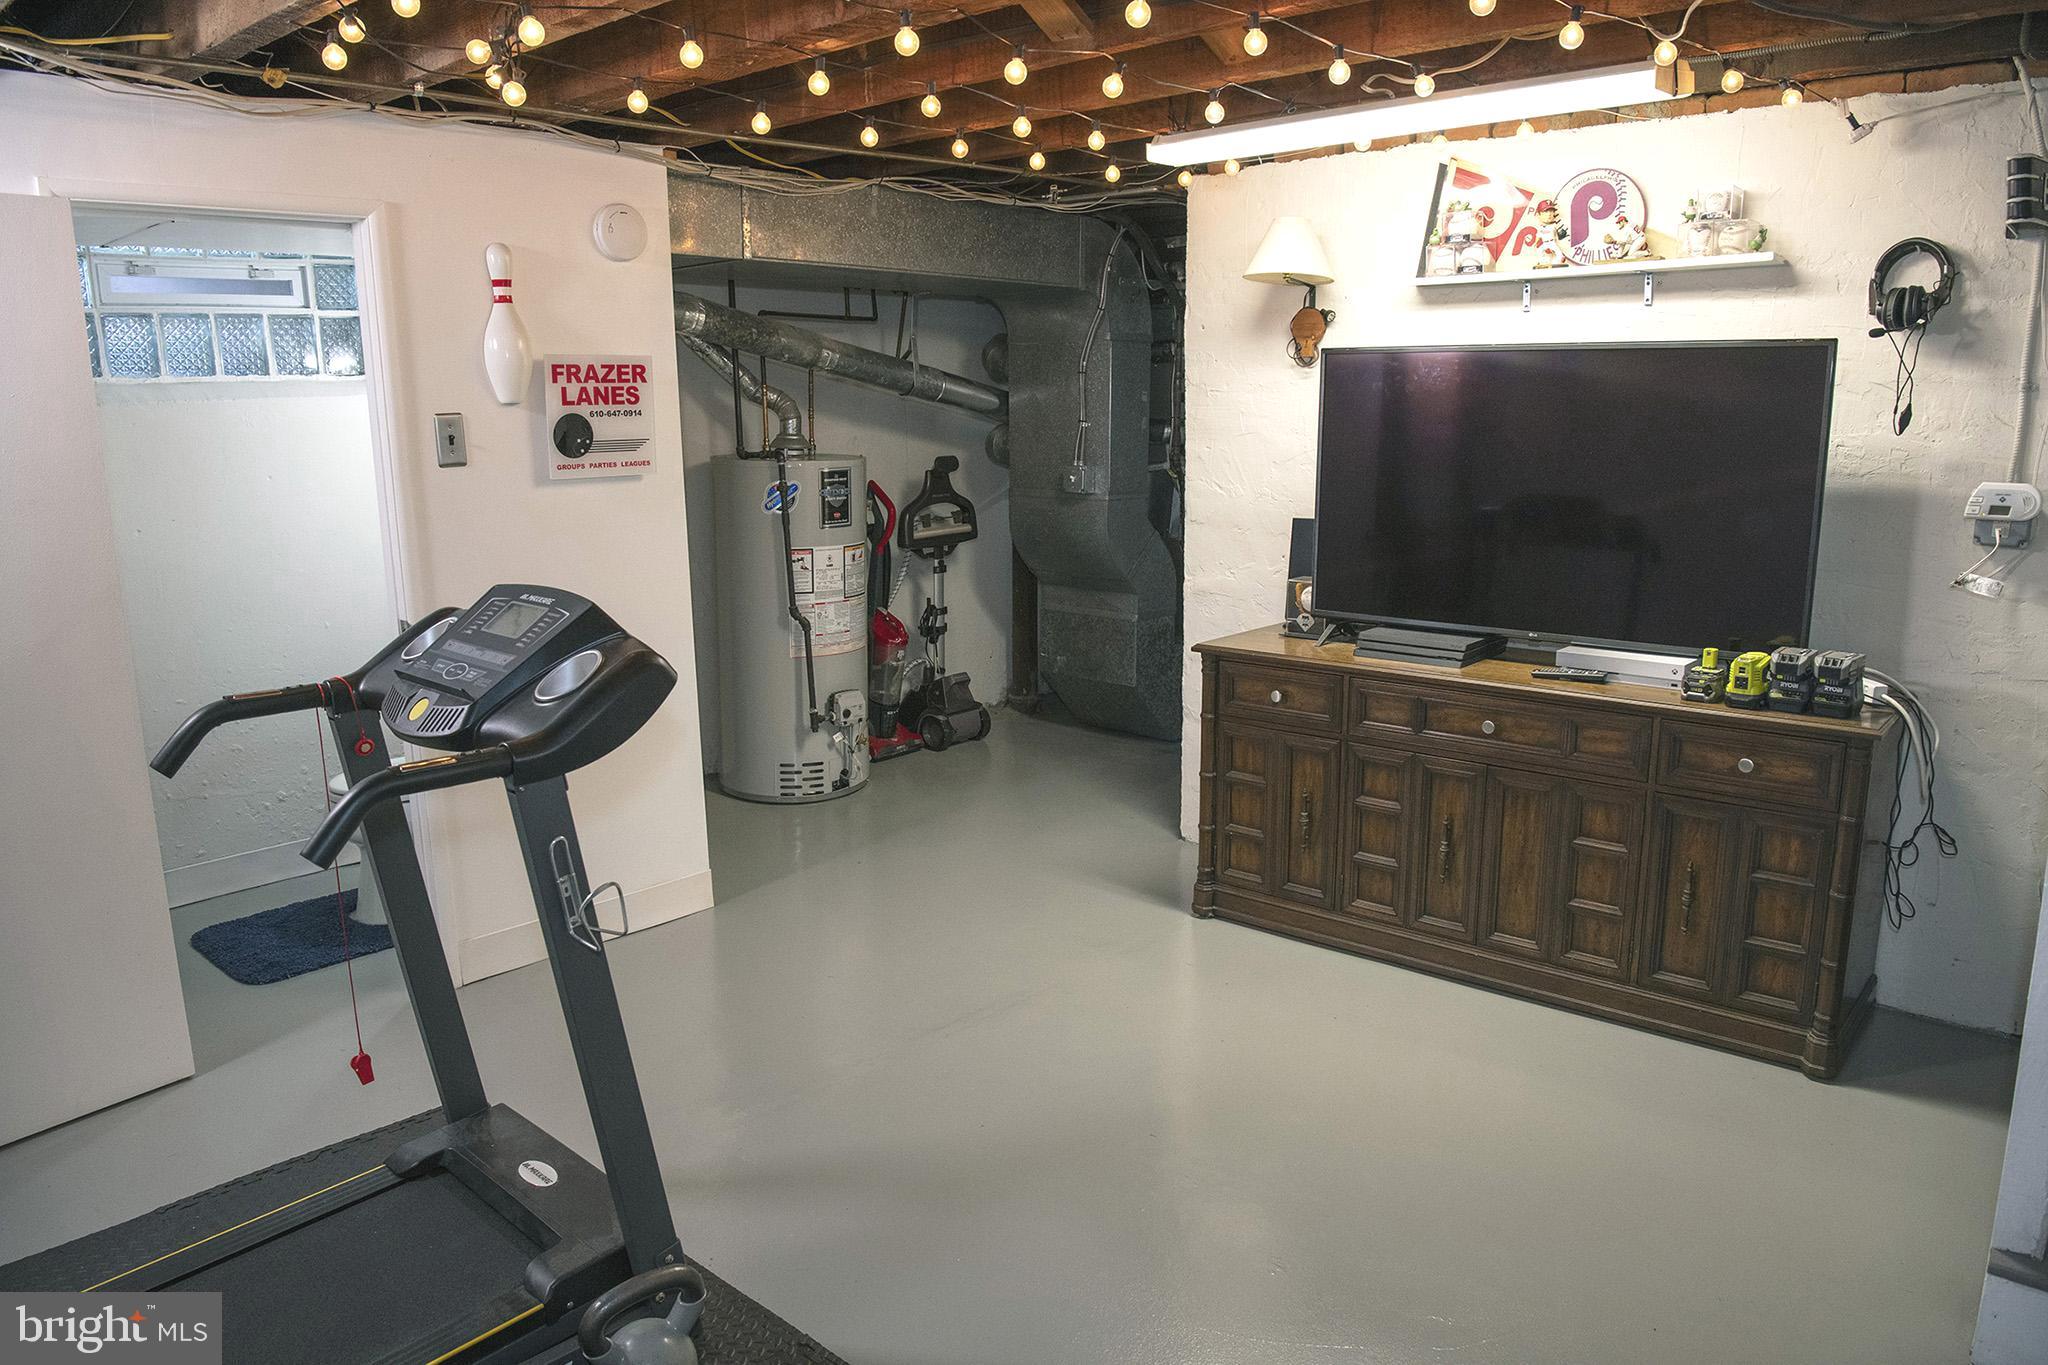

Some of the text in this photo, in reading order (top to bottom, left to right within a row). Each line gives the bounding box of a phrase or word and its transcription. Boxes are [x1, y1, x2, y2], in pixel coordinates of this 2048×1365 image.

[551, 363, 648, 384] FRAZER
[560, 385, 641, 407] LANES
[589, 409, 643, 418] 610-647-0914
[556, 460, 651, 471] GROUPS PARTIES LEAGUES
[1779, 681, 1800, 689] RYOBI
[1823, 685, 1844, 693] RYOBI
